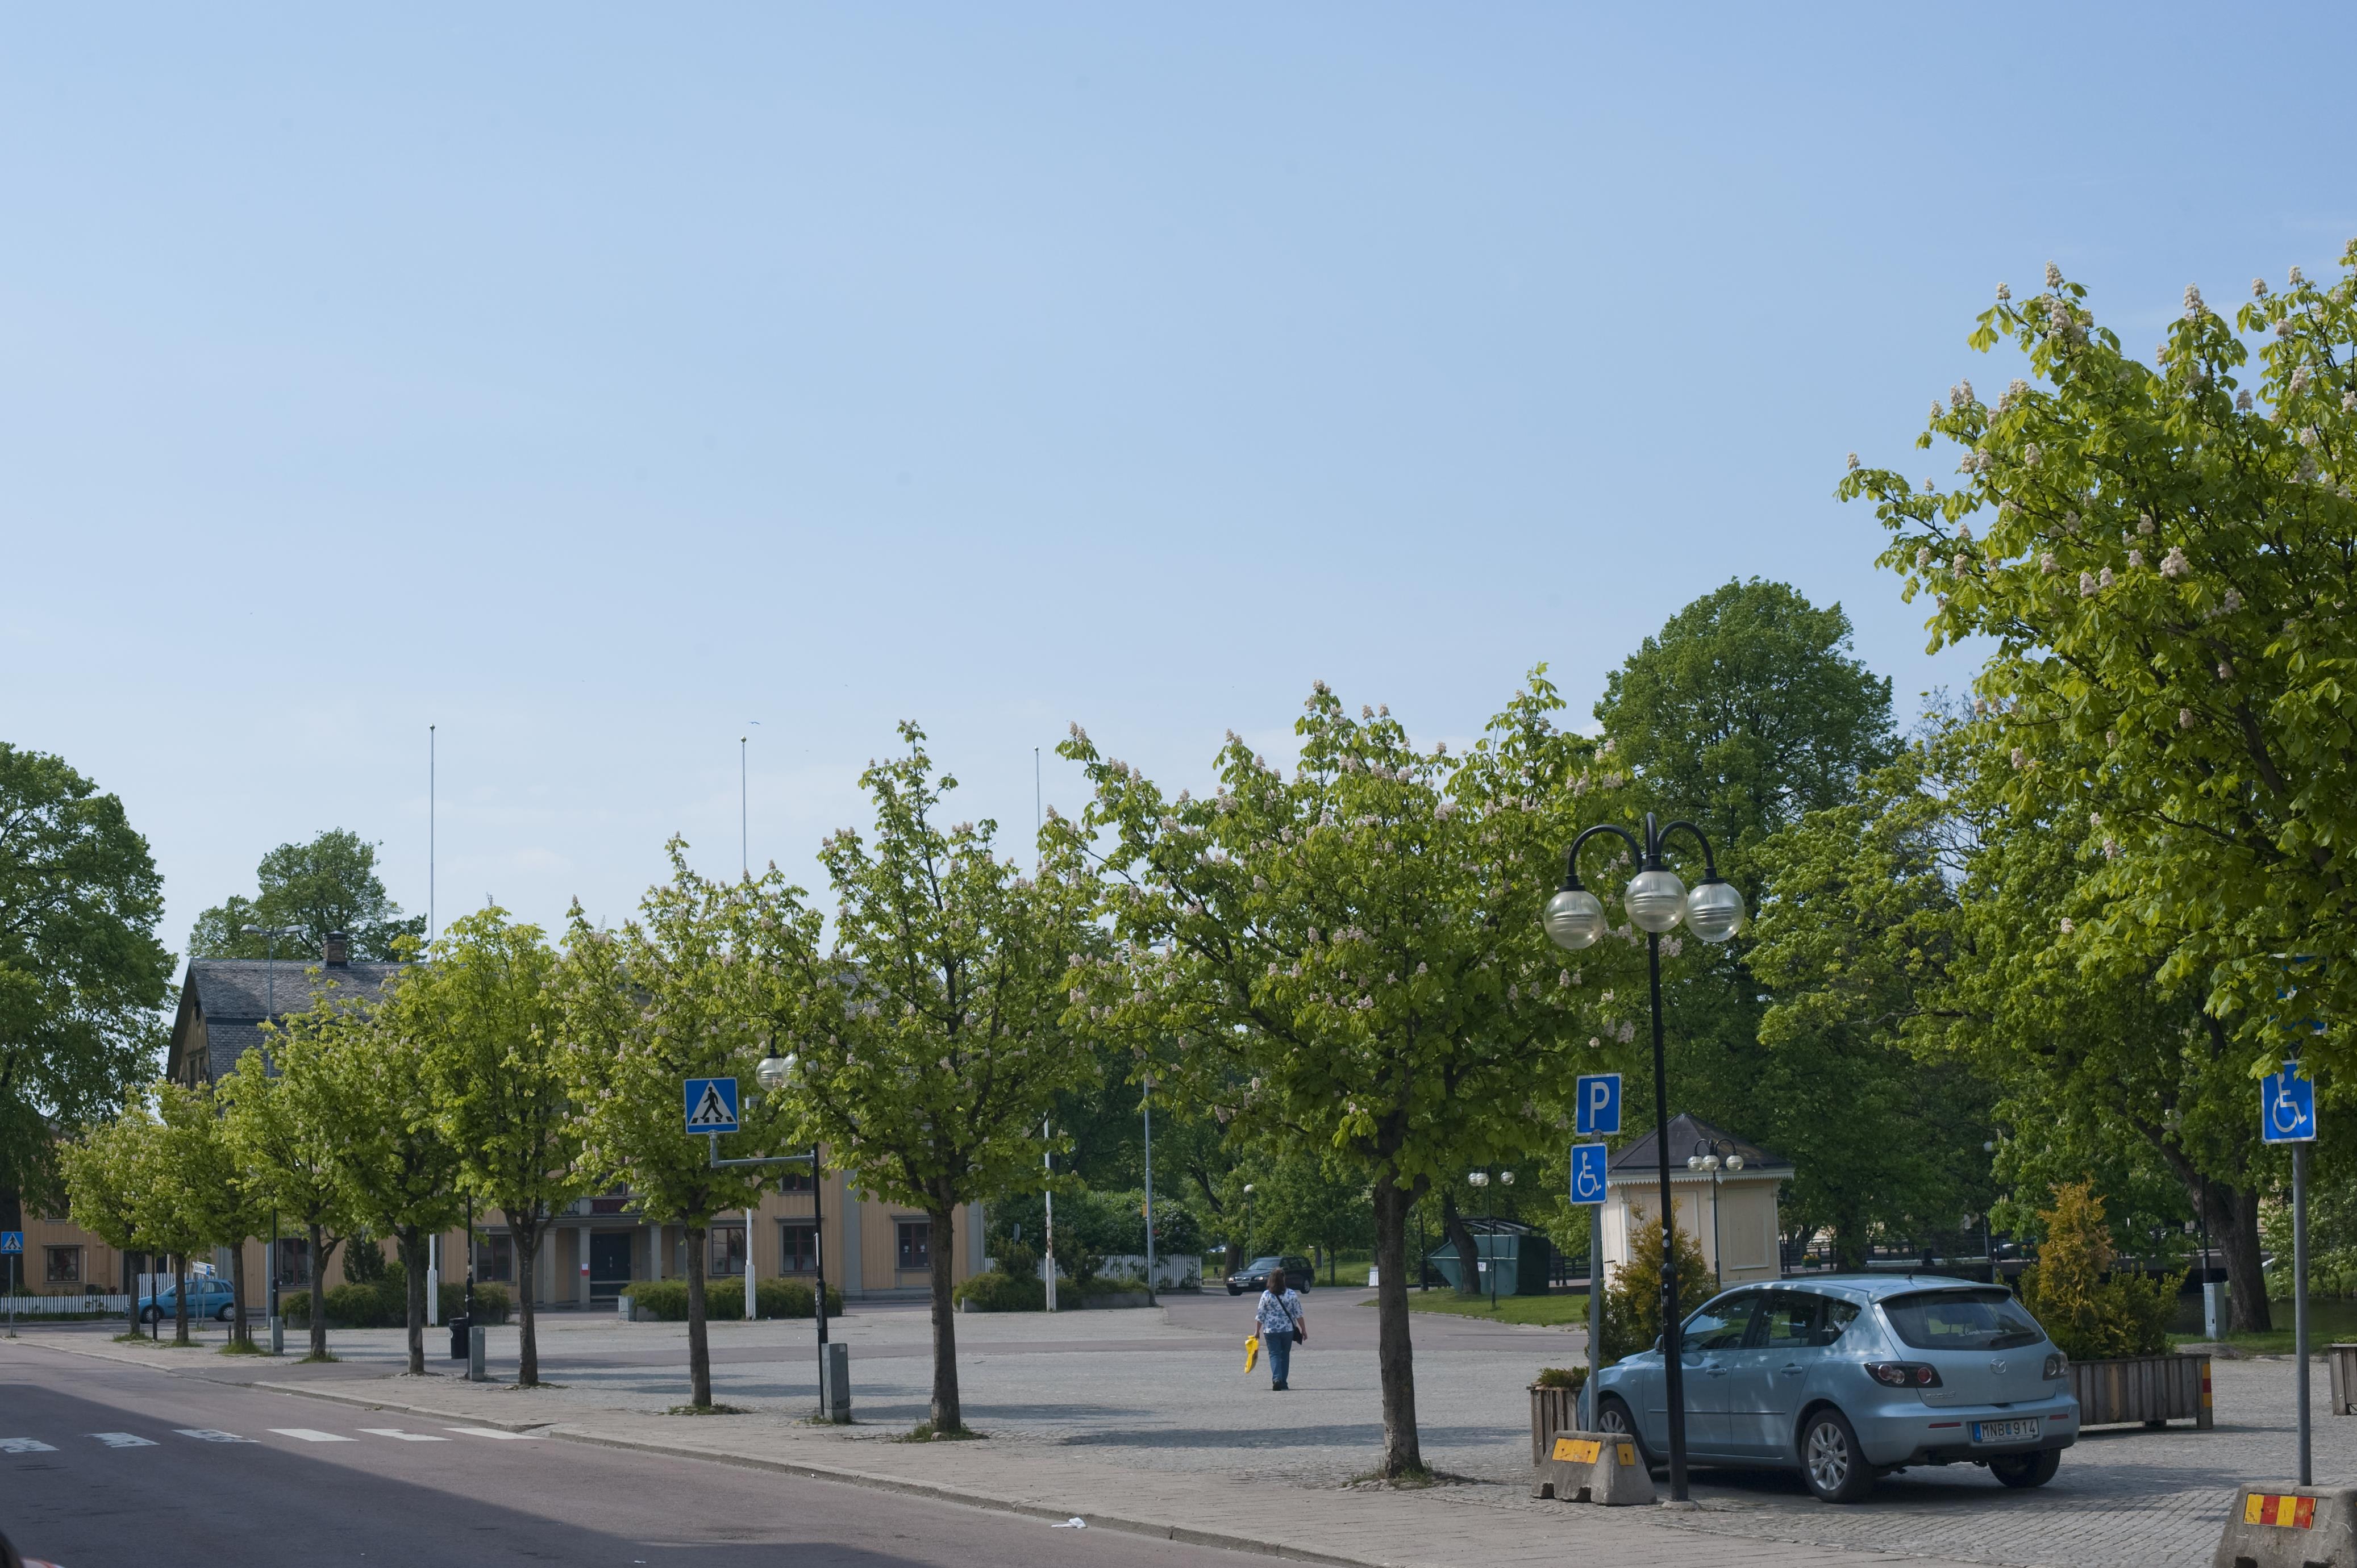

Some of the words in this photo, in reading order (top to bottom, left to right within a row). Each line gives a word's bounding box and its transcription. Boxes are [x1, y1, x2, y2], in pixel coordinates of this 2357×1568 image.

[1590, 1082, 1610, 1128] P
[1981, 1423, 2005, 1437] MNB
[2013, 1420, 2036, 1434] 914
